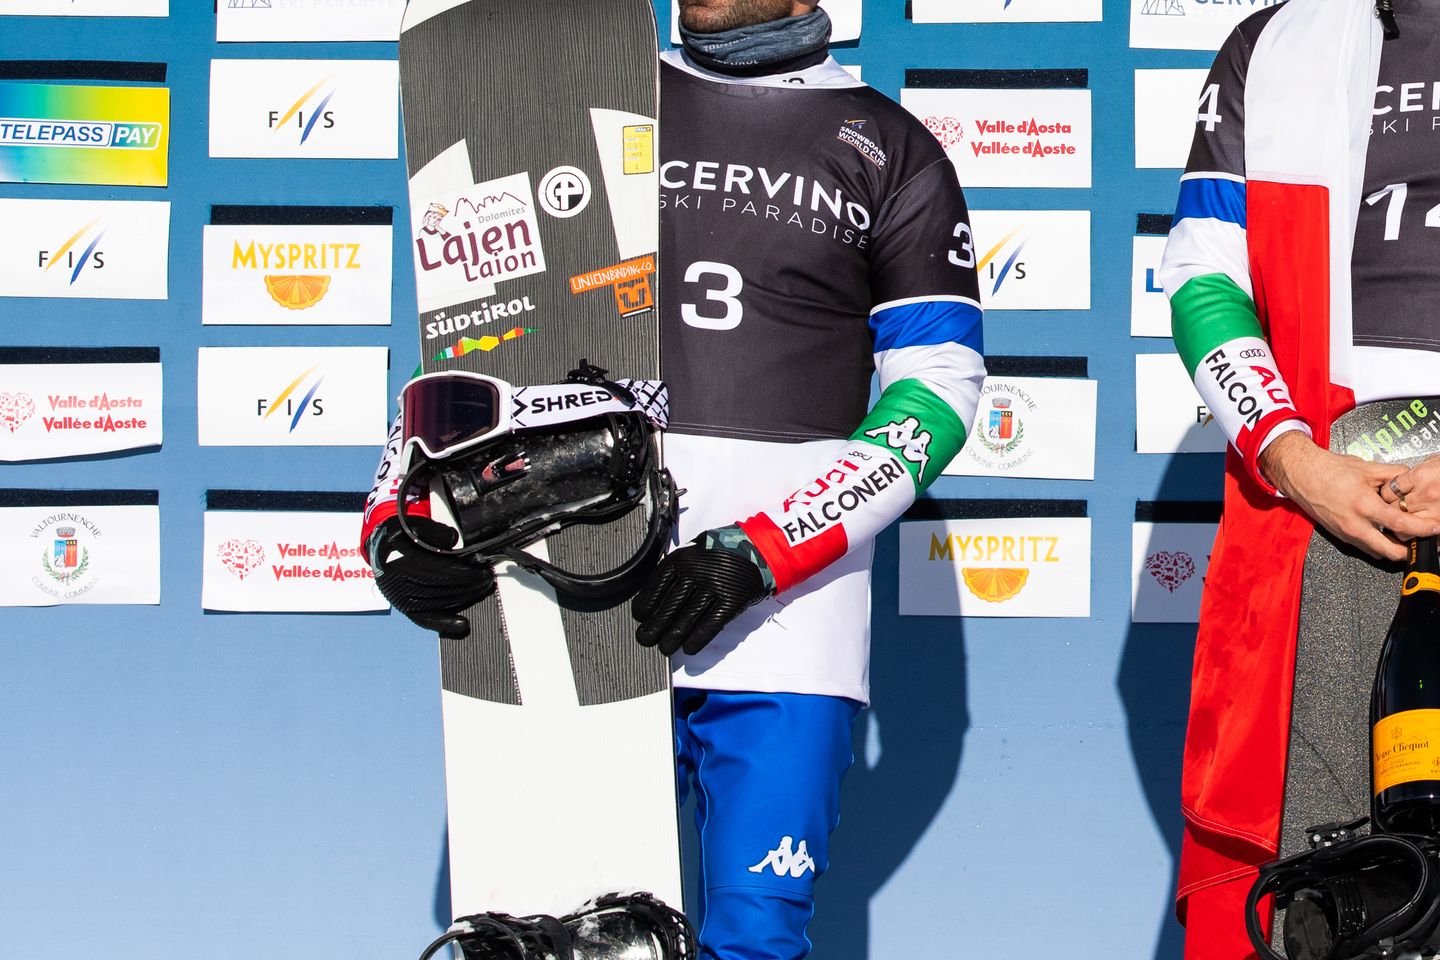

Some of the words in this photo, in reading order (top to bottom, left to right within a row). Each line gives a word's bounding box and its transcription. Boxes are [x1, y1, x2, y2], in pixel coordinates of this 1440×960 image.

[268, 112, 334, 129] FIS
[976, 120, 1016, 136] Valle
[0, 123, 103, 143] TELEPASS
[115, 126, 155, 144] PAY
[838, 130, 870, 154] WORLD
[869, 150, 885, 167] CUP
[971, 140, 1021, 158] Vallée
[659, 160, 871, 231] CERVINO
[478, 206, 526, 224] Dolomites
[722, 198, 868, 250] PARADISE
[231, 239, 361, 270] MYSPRITZ
[416, 219, 532, 272] Lajen
[948, 222, 976, 269] 3
[39, 250, 104, 270] FIS
[463, 250, 537, 282] Laion
[681, 261, 744, 330] 3
[48, 395, 87, 411] Valle
[258, 398, 324, 417] FIS
[980, 383, 1038, 412] TOURNENCHE
[43, 415, 92, 432] Vallée
[782, 458, 906, 543] FALCONERI
[30, 513, 102, 540] VALTOURNENCHE
[277, 544, 317, 560] Valle
[318, 543, 362, 559] d'Aost
[929, 531, 1060, 563] MYSPRITZ
[272, 563, 322, 581] Vallée
[1392, 740, 1429, 754] Clicquot
